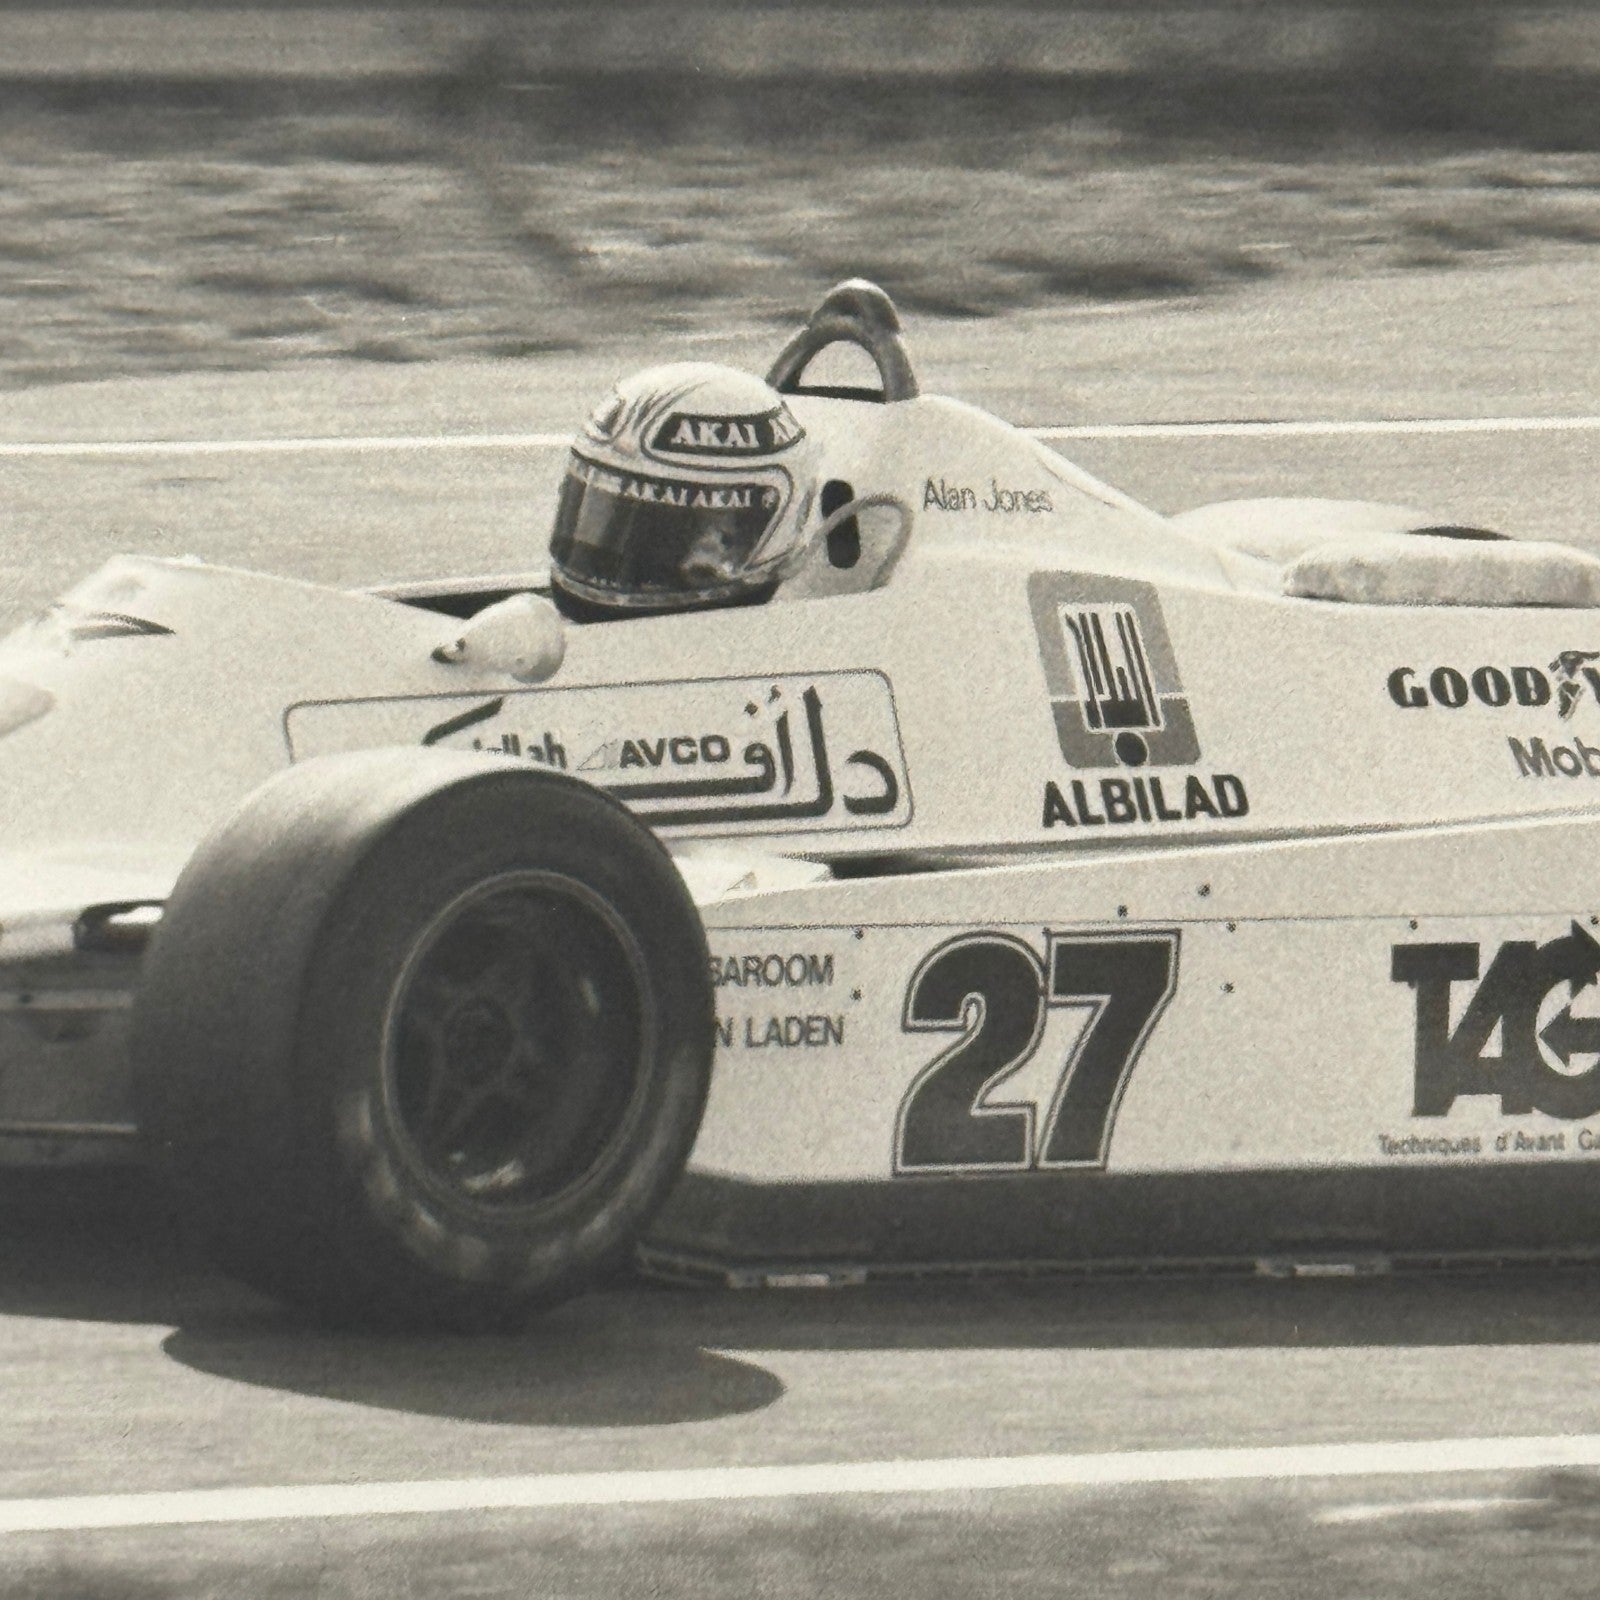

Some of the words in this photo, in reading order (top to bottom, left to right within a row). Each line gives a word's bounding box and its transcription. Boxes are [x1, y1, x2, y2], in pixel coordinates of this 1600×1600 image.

[671, 418, 760, 448] AKAI
[624, 479, 688, 507] AKAI
[691, 488, 752, 508] AKAI
[923, 478, 977, 512] Alan
[983, 479, 1053, 513] Jones
[619, 733, 731, 769] AVCO
[1042, 773, 1249, 827] ALBILAD
[745, 1014, 845, 1048] LADEN
[893, 927, 1181, 1177] 27
